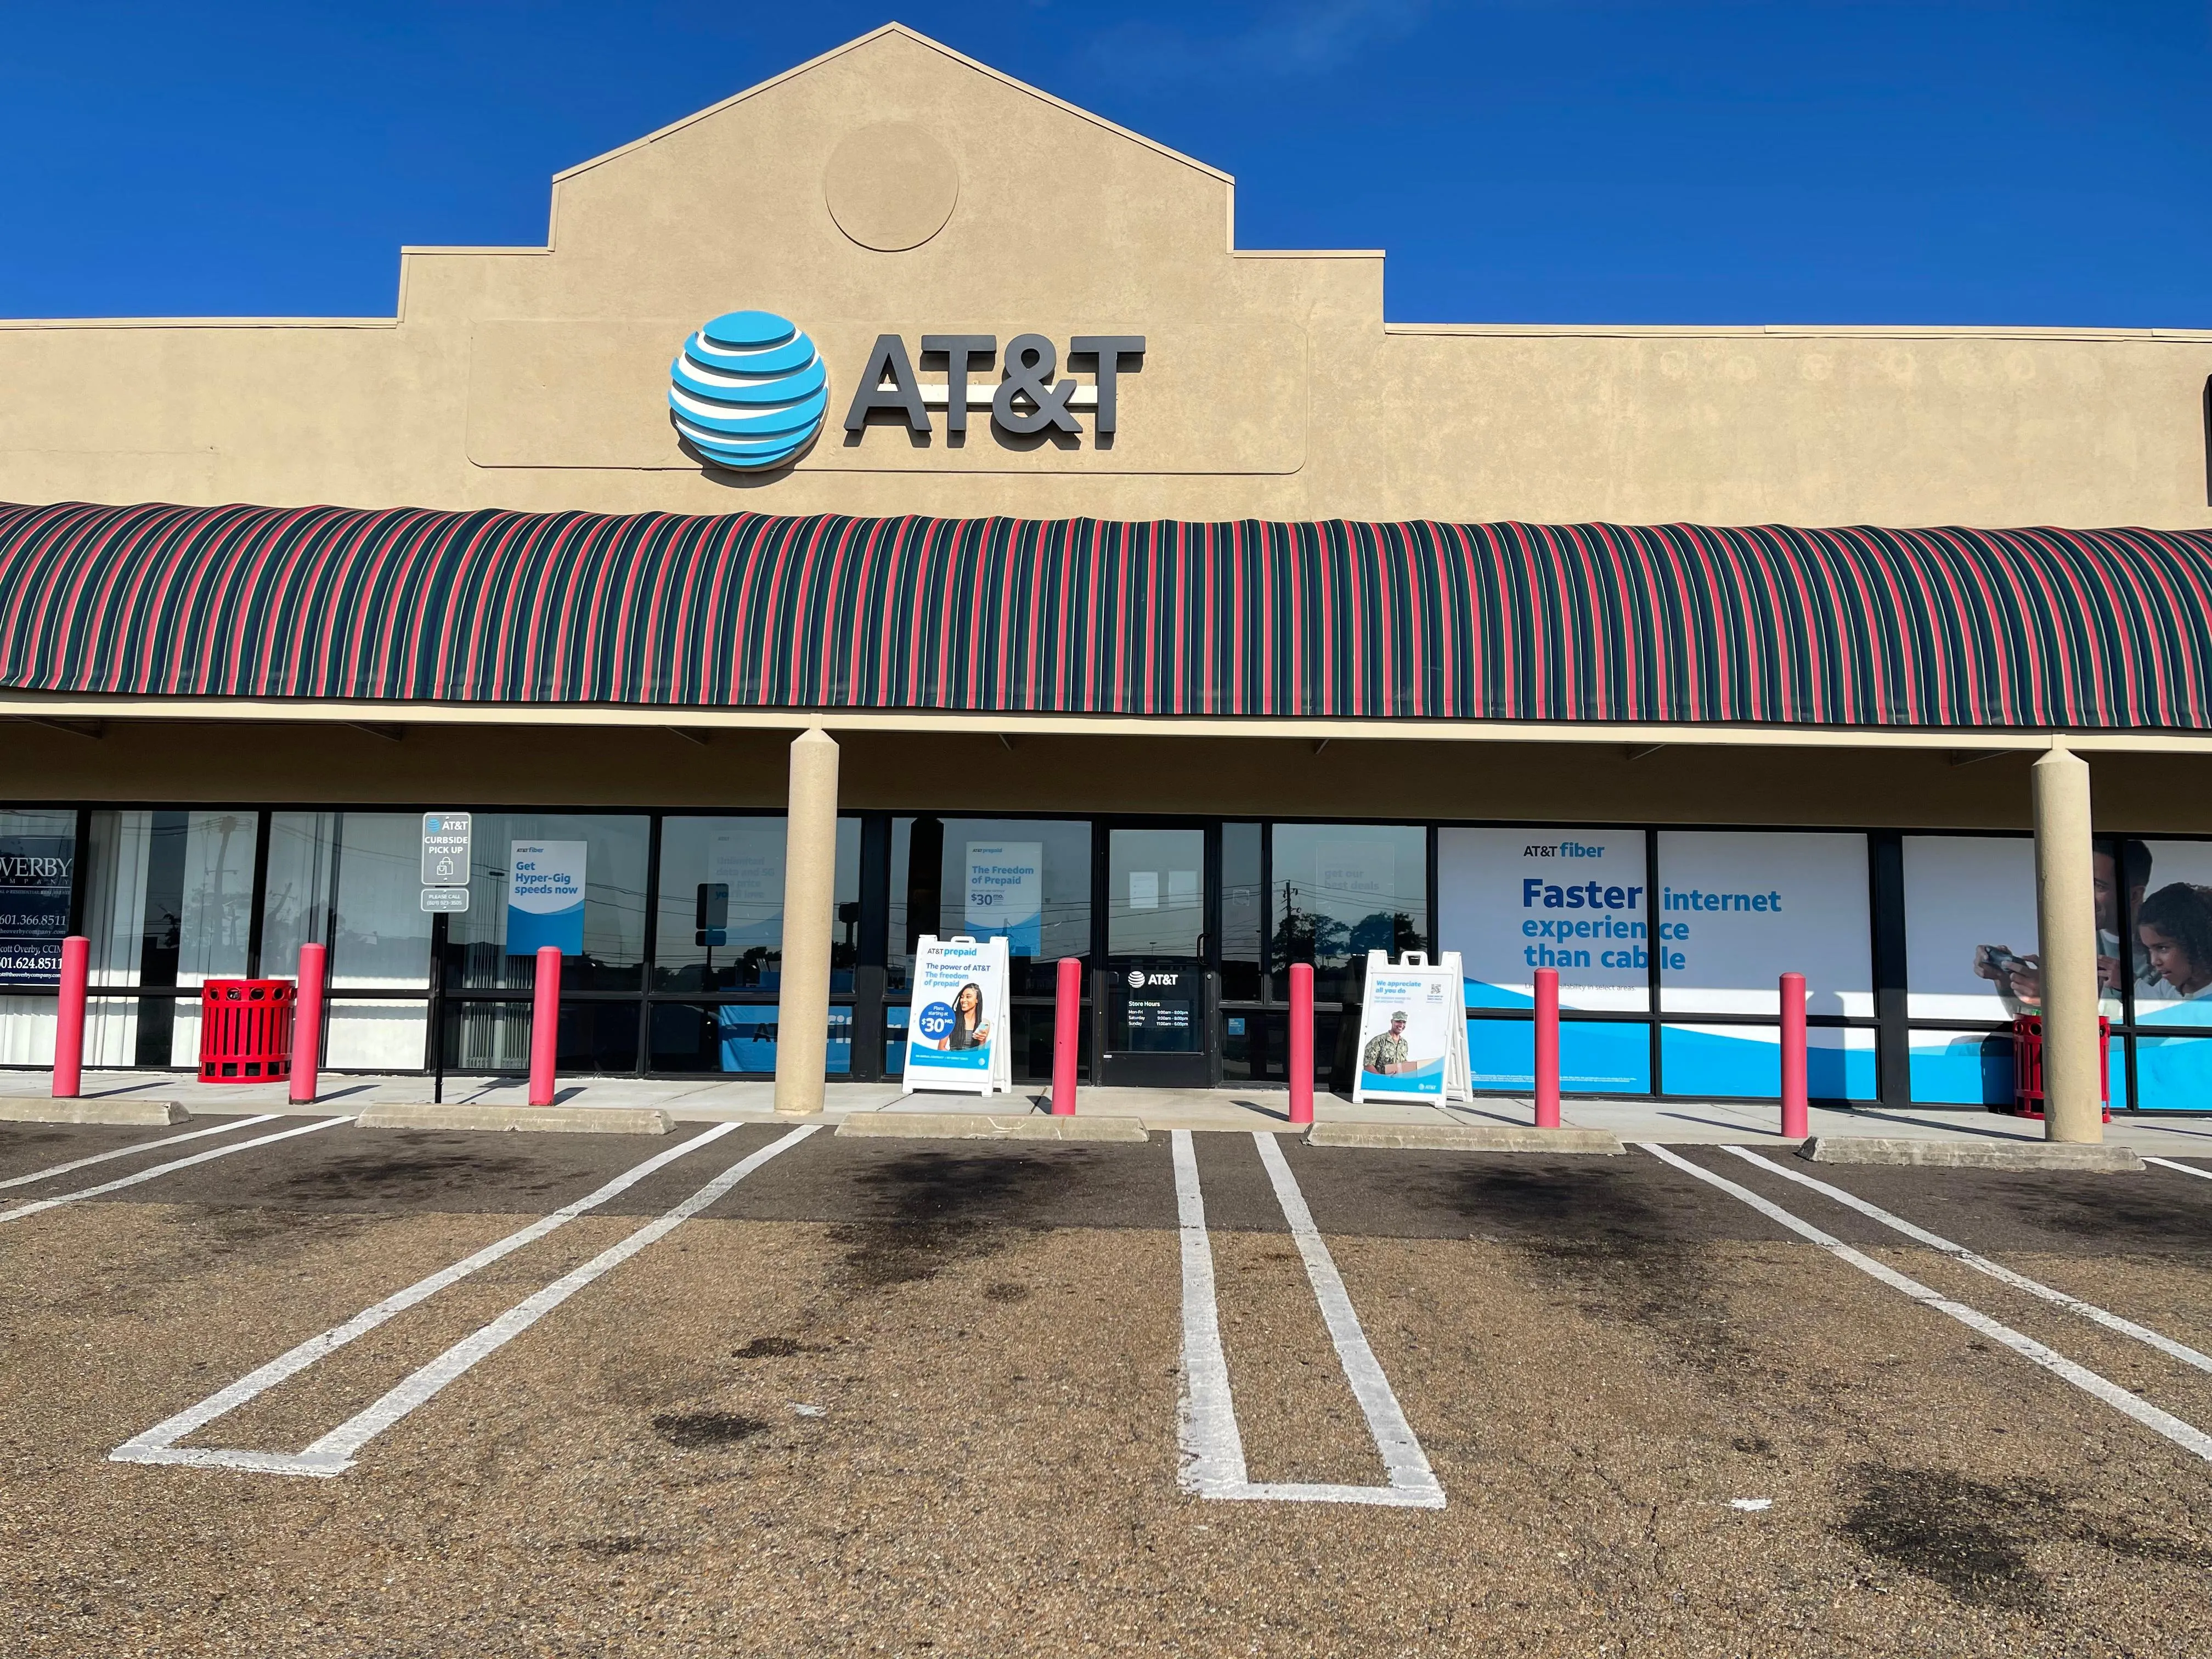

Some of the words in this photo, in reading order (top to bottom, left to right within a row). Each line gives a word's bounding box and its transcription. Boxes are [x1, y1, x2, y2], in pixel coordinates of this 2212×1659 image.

[844, 333, 1146, 433] AT&T
[442, 821, 468, 830] AT&T
[1523, 845, 1558, 857] AT&T
[1559, 842, 1605, 857] fiber
[516, 861, 535, 871] Get
[972, 866, 990, 874] The
[992, 866, 1034, 874] Freedom
[516, 873, 571, 884] Hyper-Gig
[1325, 870, 1343, 879] get
[985, 876, 1022, 886] Prepaid
[1325, 880, 1348, 889] best
[1351, 881, 1379, 890] deals
[515, 884, 552, 896] speeds
[1523, 879, 1643, 909] Faster
[1664, 887, 1782, 912] internet
[971, 893, 992, 905] $30
[0, 915, 66, 926] 601.366.8511
[0, 928, 66, 936] heoverbycompany.com
[1522, 915, 1689, 944] experience
[14, 944, 41, 956] Overby,
[944, 948, 977, 957] prepaid
[1525, 944, 1590, 968] than
[1601, 945, 1686, 970] cable
[0, 957, 63, 969] 01.624.8511
[1148, 974, 1178, 985] AT&T
[922, 1018, 944, 1032] $30
